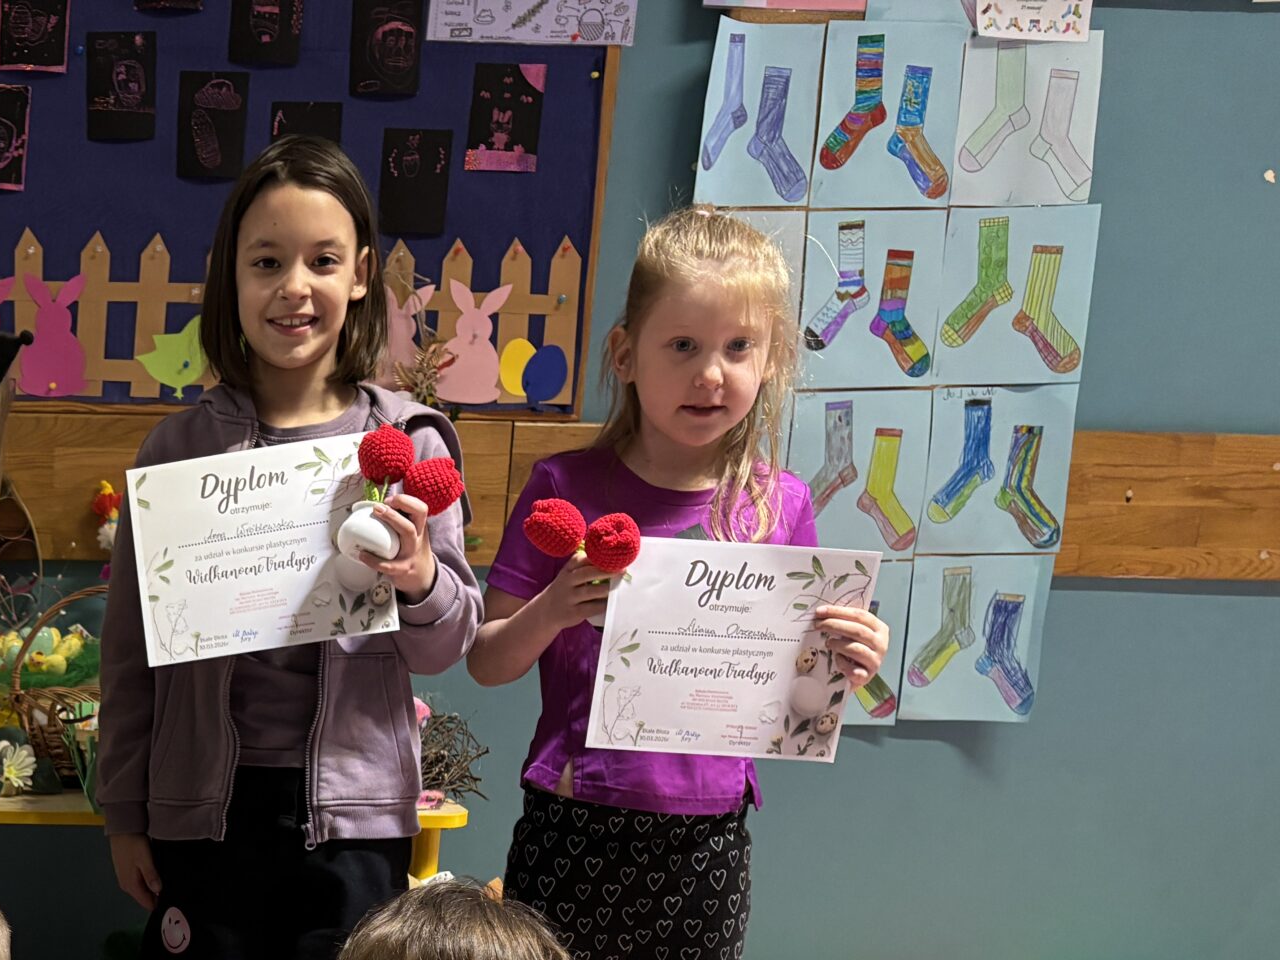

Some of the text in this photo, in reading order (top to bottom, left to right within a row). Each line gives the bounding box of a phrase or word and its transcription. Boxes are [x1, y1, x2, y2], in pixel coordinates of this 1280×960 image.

[200, 465, 288, 514] Dyplom
[229, 502, 272, 515] otrzymuje:
[203, 549, 224, 559] udział
[232, 544, 264, 555] konkursie
[265, 537, 307, 549] plastycznym
[185, 551, 317, 584] Wielkanocne Tradycje
[685, 560, 776, 607] Dyplom
[709, 603, 752, 613] otrzymuje:
[669, 644, 691, 653] udział
[698, 645, 731, 655] konkursie
[732, 648, 773, 658] plastycznym
[647, 657, 776, 685] Wielkanocne Tradycje
